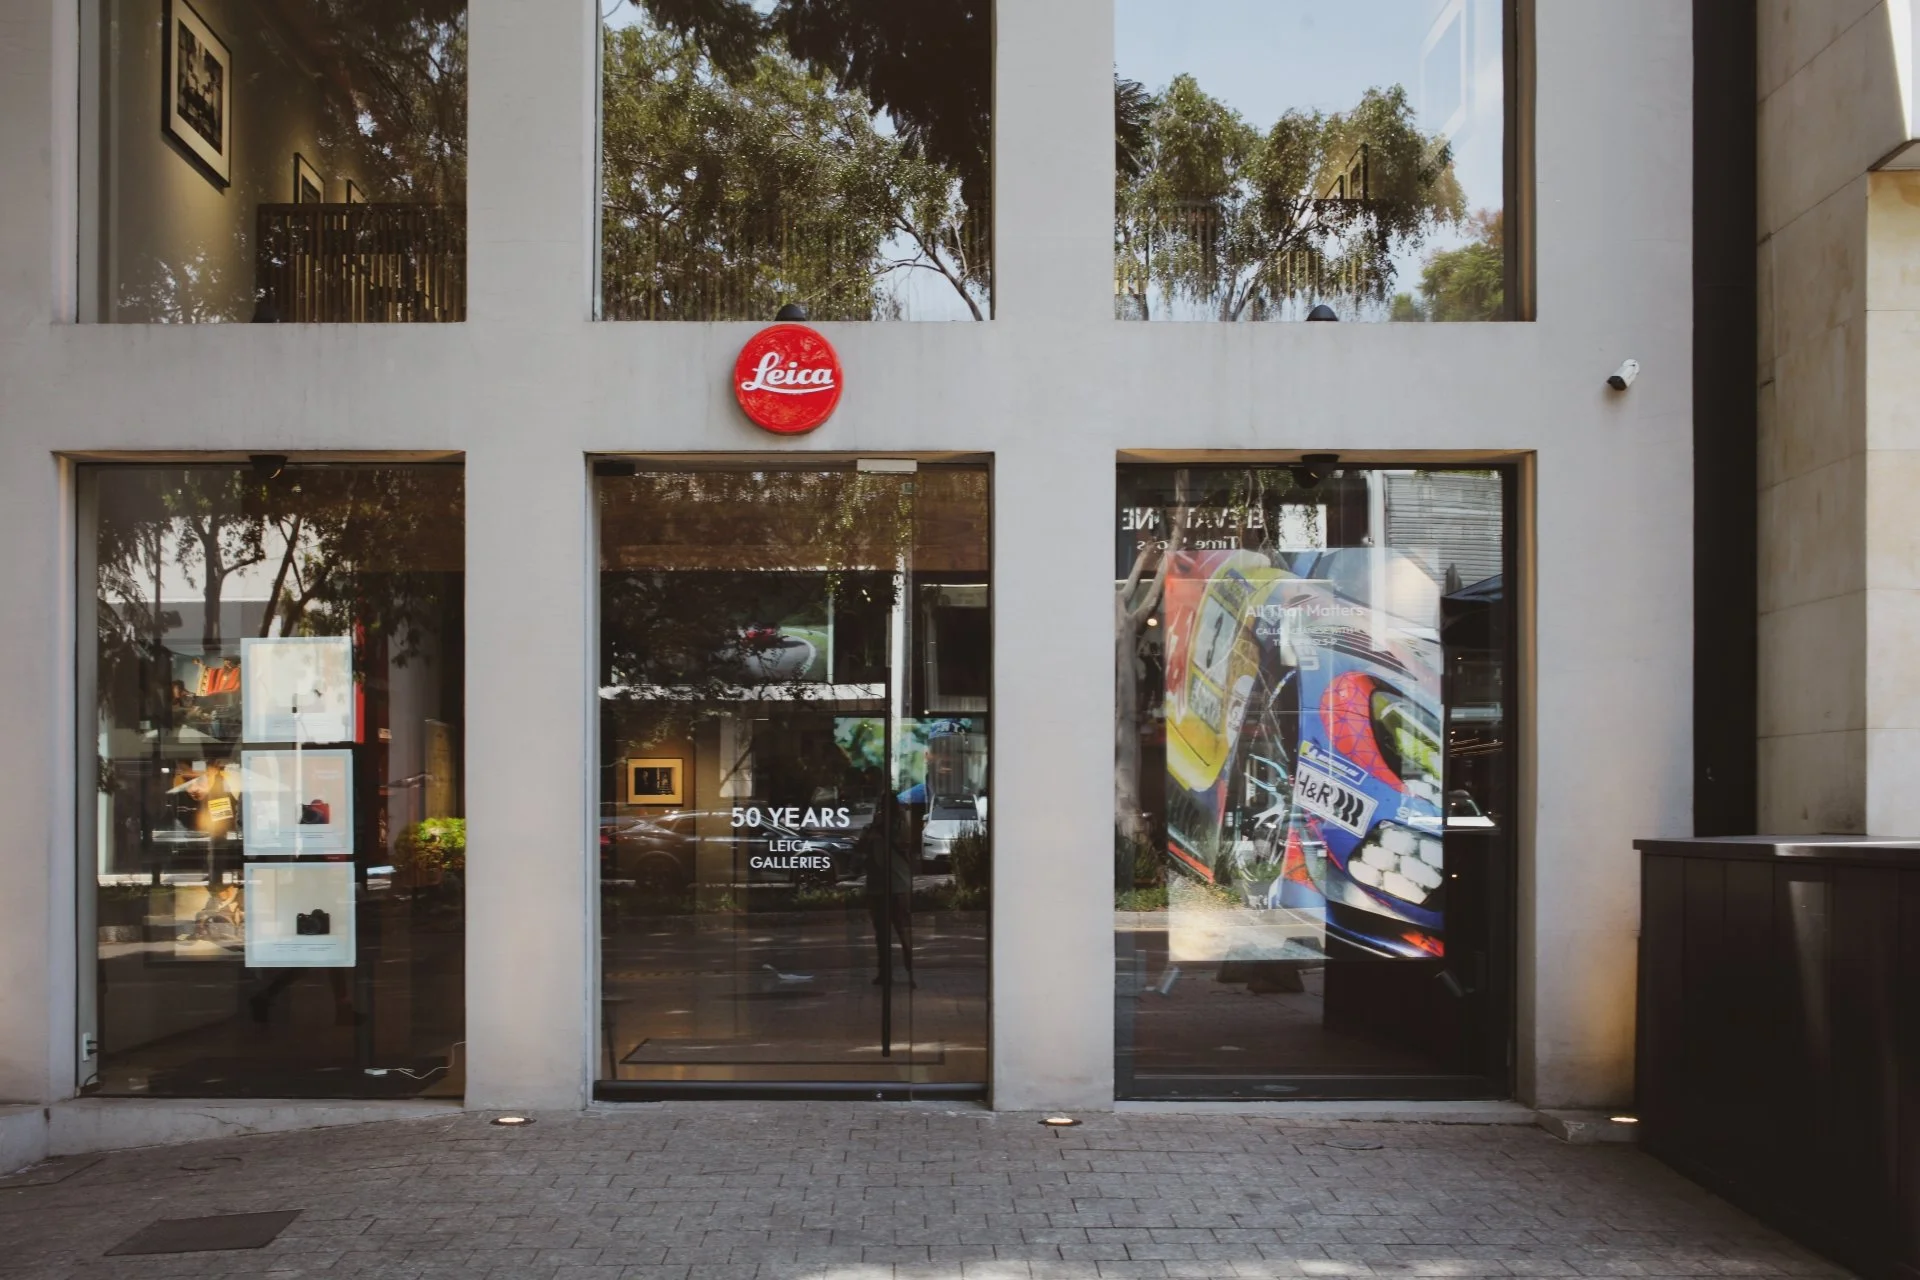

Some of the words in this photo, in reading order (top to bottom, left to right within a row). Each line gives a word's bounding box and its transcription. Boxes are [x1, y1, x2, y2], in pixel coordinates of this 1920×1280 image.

[741, 352, 835, 394] Leica
[1306, 604, 1365, 618] Matters
[730, 807, 761, 828] 50
[768, 807, 850, 828] YEARS
[769, 840, 813, 852] LEICA
[750, 856, 831, 869] GALLERIES
